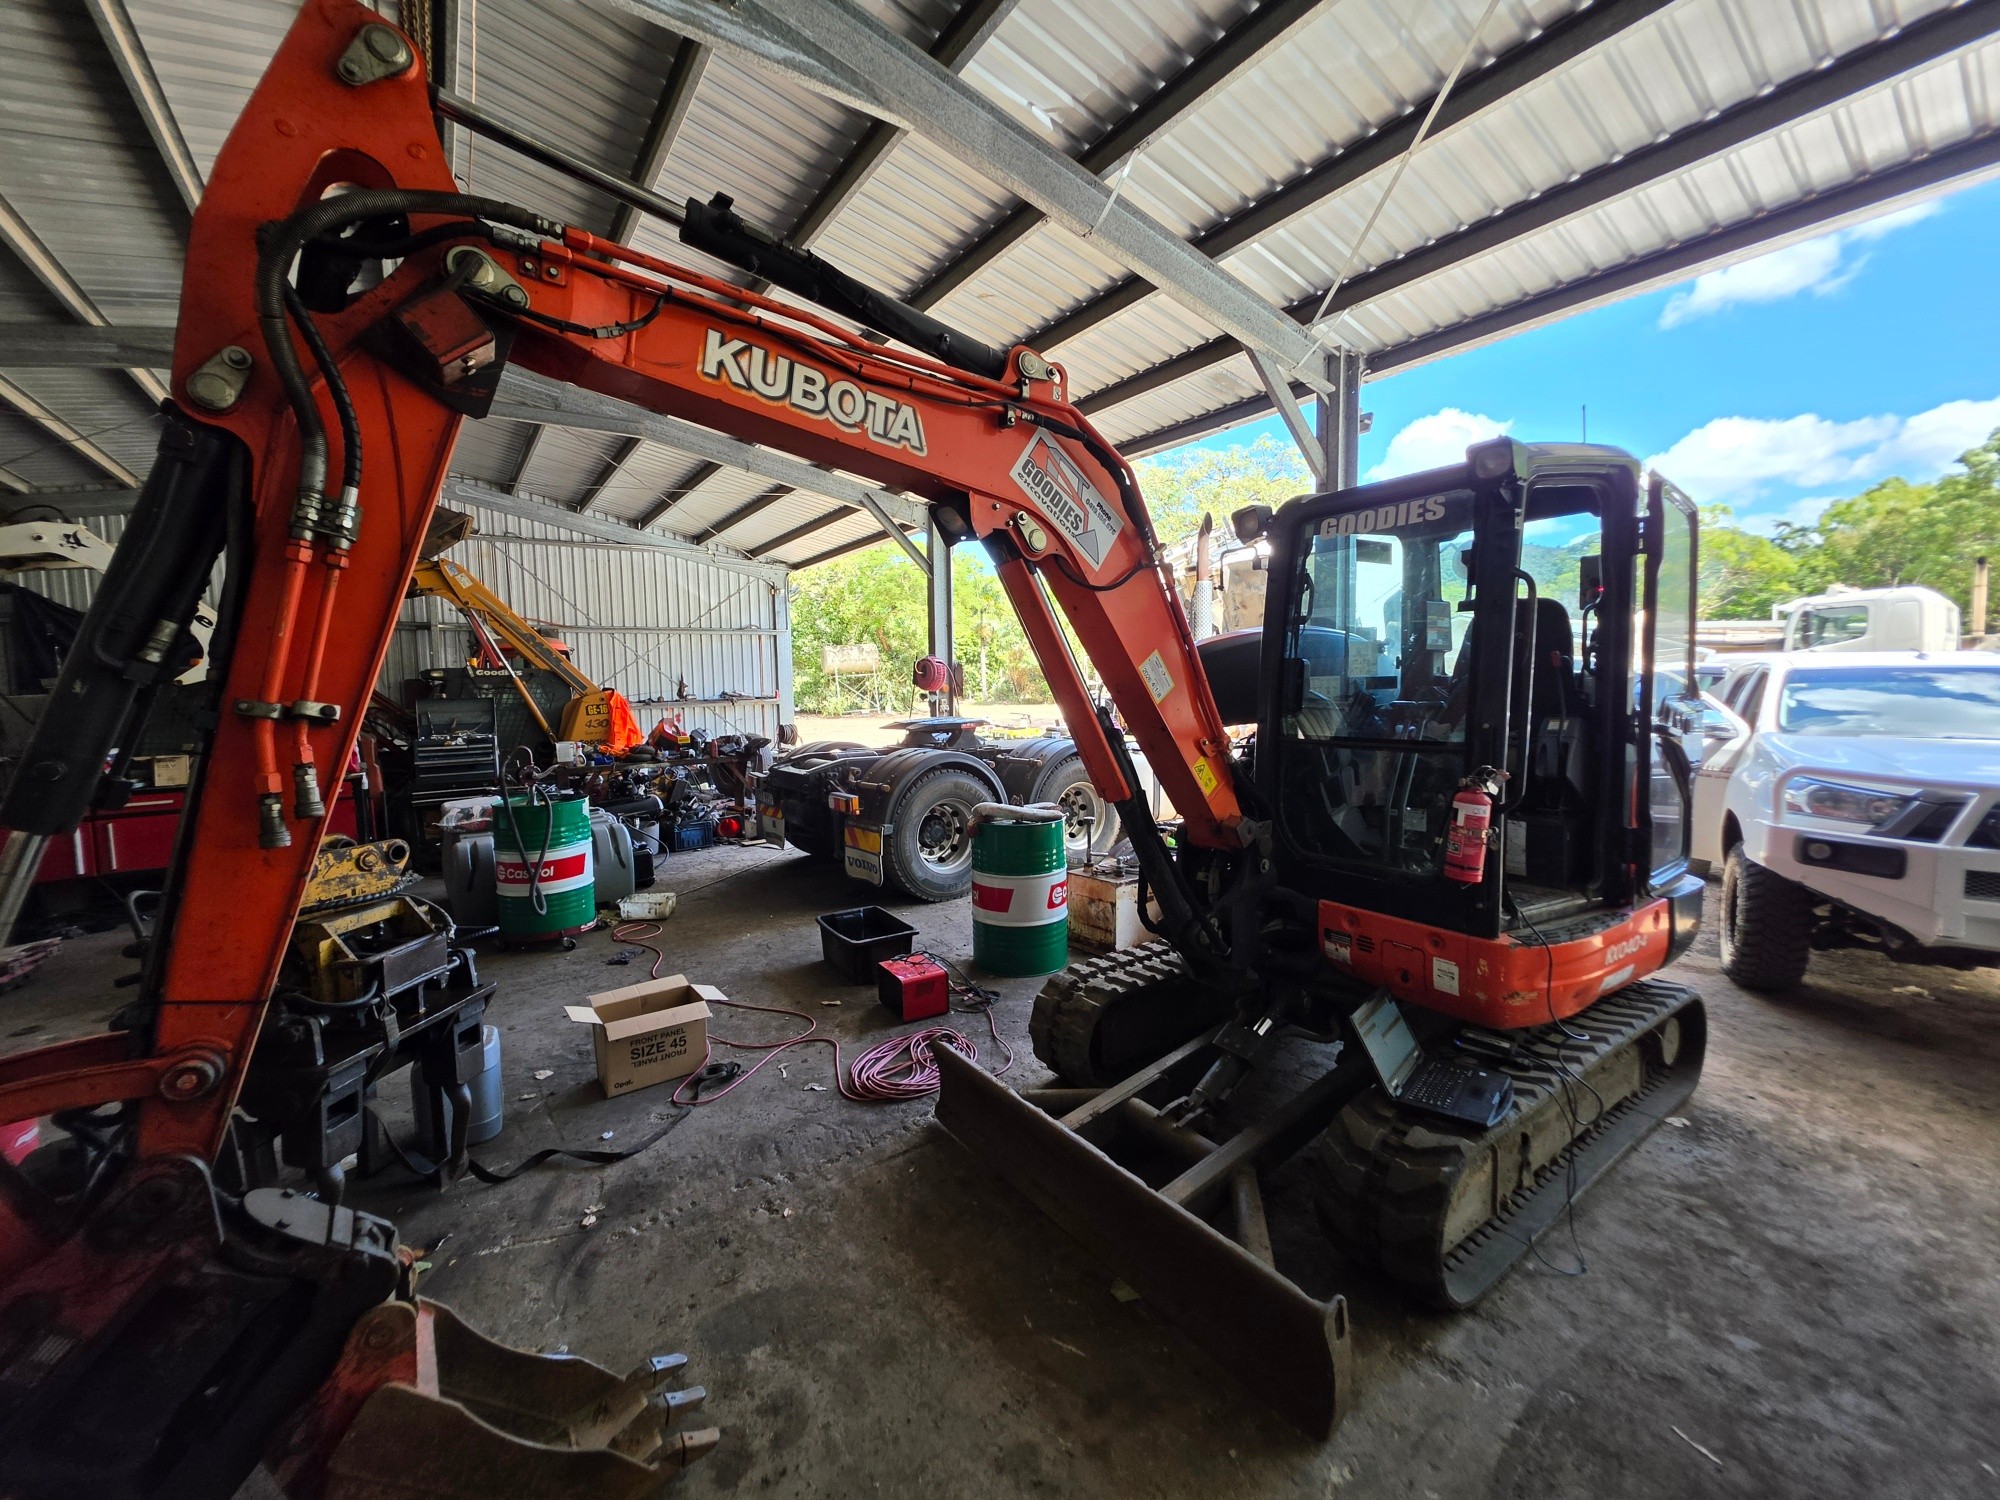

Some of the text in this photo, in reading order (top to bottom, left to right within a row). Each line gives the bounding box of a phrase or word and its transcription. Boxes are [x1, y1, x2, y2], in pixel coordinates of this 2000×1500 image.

[703, 329, 923, 451] KUBOTA
[1022, 458, 1083, 531] GOODIES
[1018, 472, 1076, 539] excavations
[1096, 501, 1112, 522] Phone
[1320, 495, 1446, 540] GOODIES
[588, 705, 608, 715] GE-16
[585, 719, 608, 728] 430
[507, 866, 554, 879] Casol
[847, 855, 878, 875] VOLVO
[630, 1036, 687, 1060] SIZE 45
[631, 1028, 686, 1047] FRONT PANEL
[631, 1048, 687, 1069] FRONT PANEL
